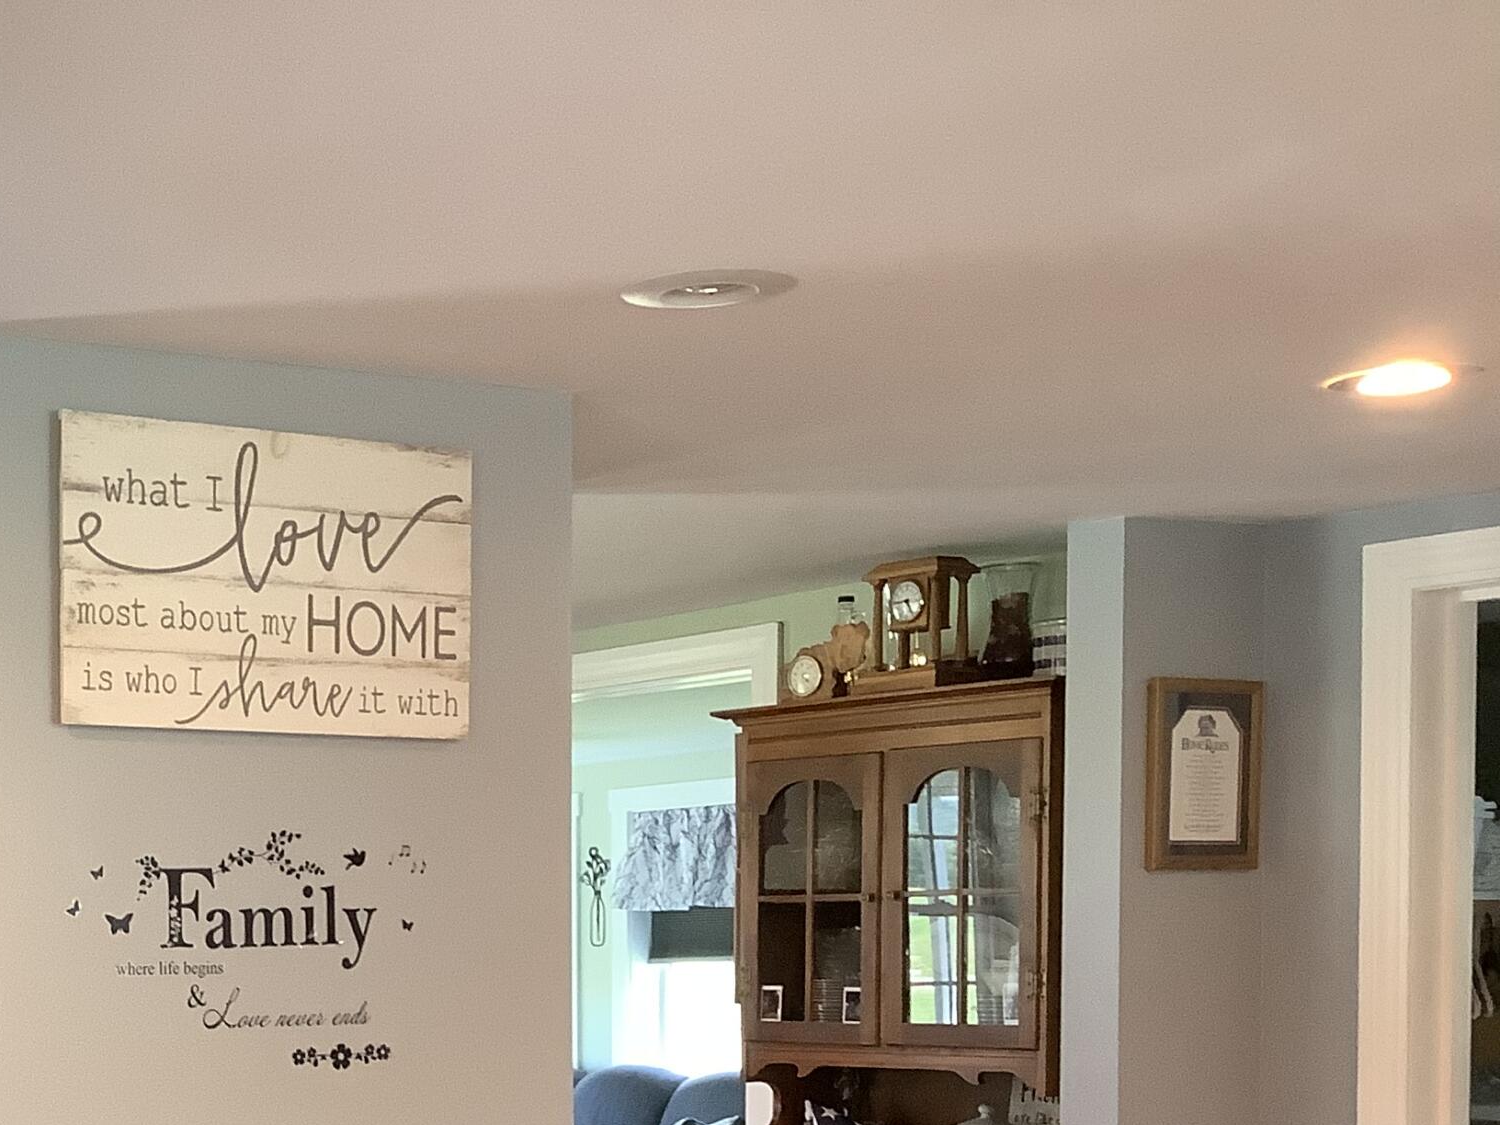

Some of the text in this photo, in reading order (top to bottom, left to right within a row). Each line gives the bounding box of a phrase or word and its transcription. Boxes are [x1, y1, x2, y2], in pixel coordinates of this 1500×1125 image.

[103, 441, 462, 592] what I love
[77, 594, 457, 660] most about my HOME
[82, 633, 458, 724] is who I share it with
[159, 867, 377, 969] Family
[116, 960, 224, 978] where life begins
[187, 984, 370, 1029] & Love never ends
